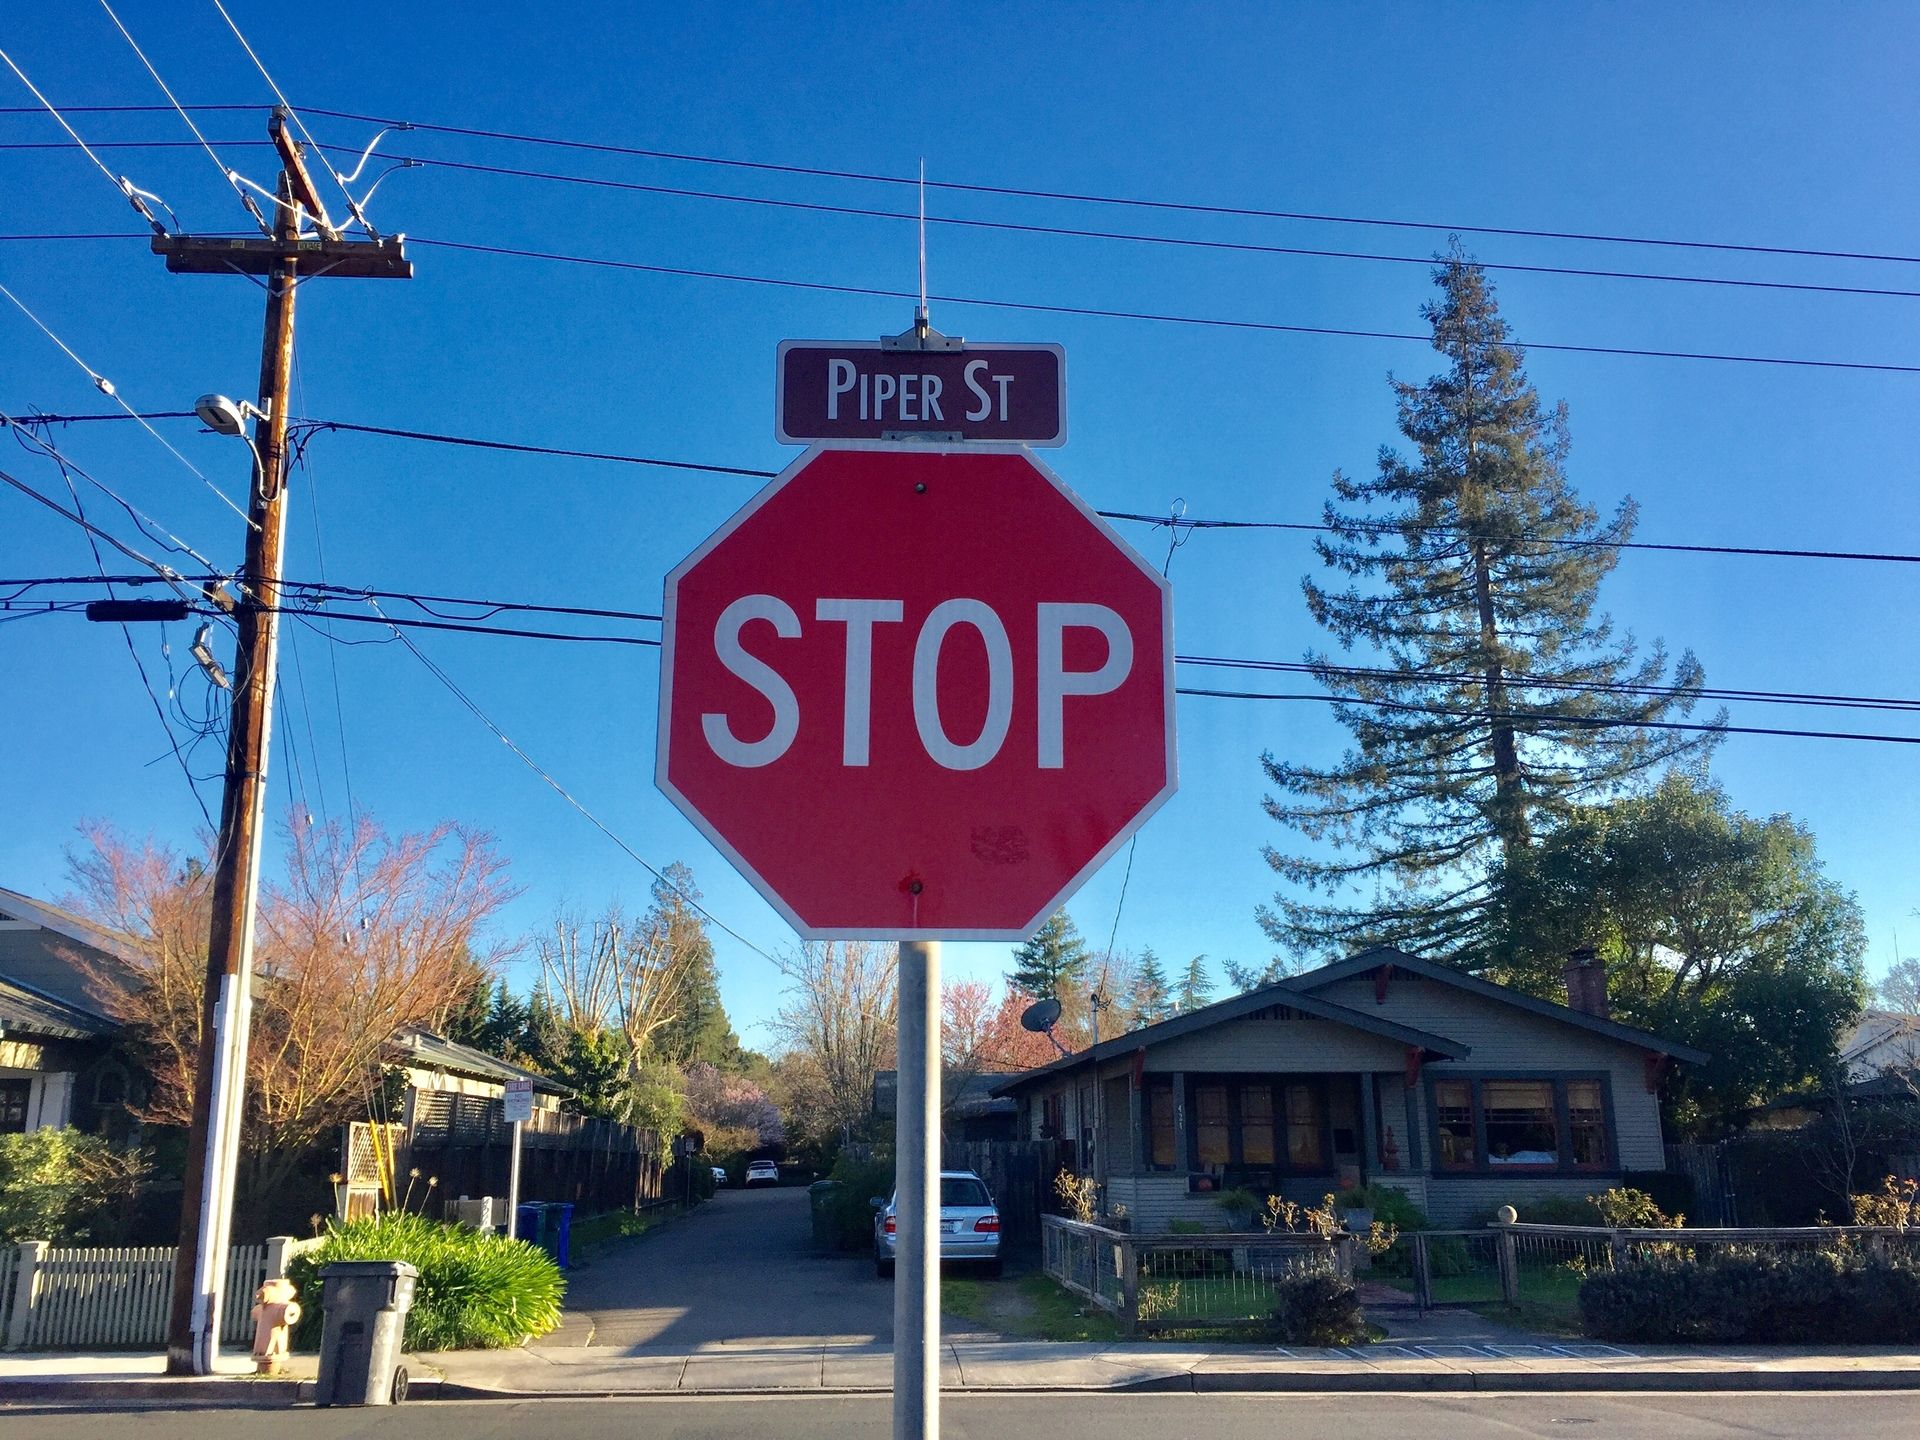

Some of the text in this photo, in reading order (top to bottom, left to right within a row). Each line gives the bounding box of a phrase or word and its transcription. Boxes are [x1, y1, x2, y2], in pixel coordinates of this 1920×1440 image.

[827, 358, 1015, 422] PIPER ST
[701, 593, 1134, 771] STOP
